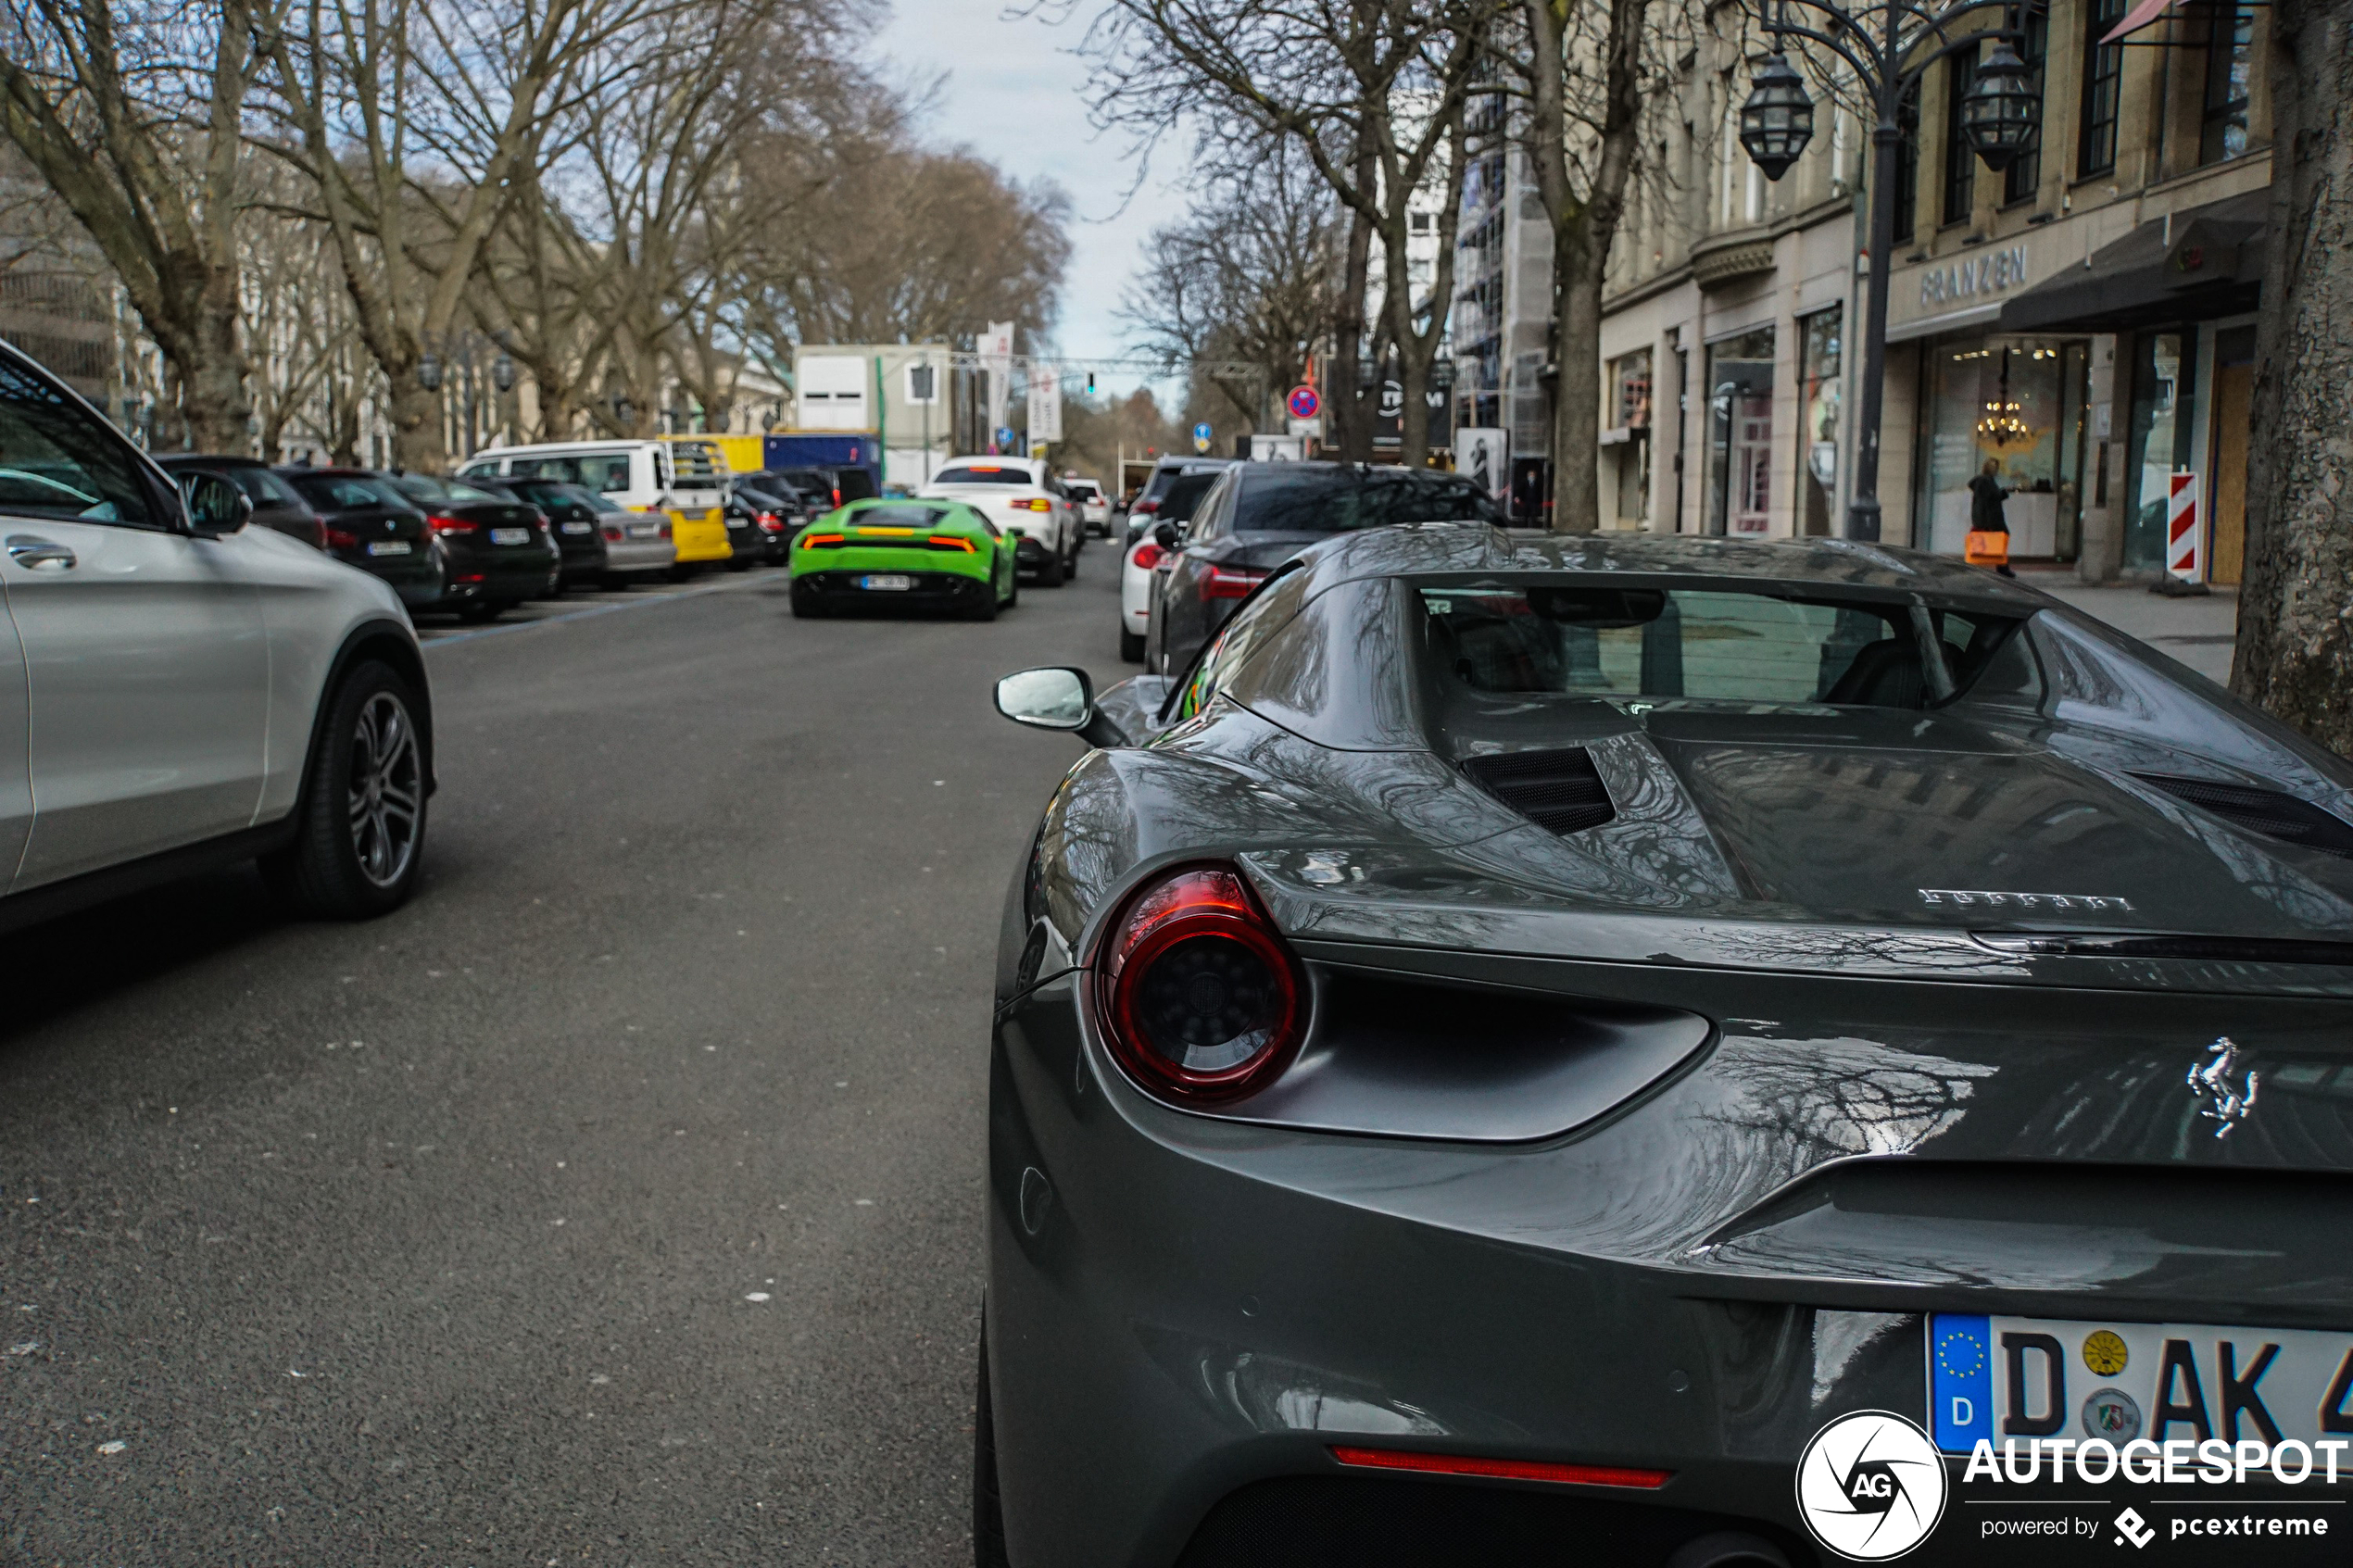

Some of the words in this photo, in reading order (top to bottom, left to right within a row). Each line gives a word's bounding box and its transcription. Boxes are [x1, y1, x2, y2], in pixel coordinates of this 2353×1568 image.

[1920, 245, 2028, 307] FRANZEN
[1953, 1397, 1974, 1427] D
[2000, 1331, 2066, 1436] D
[2148, 1337, 2285, 1449] AK
